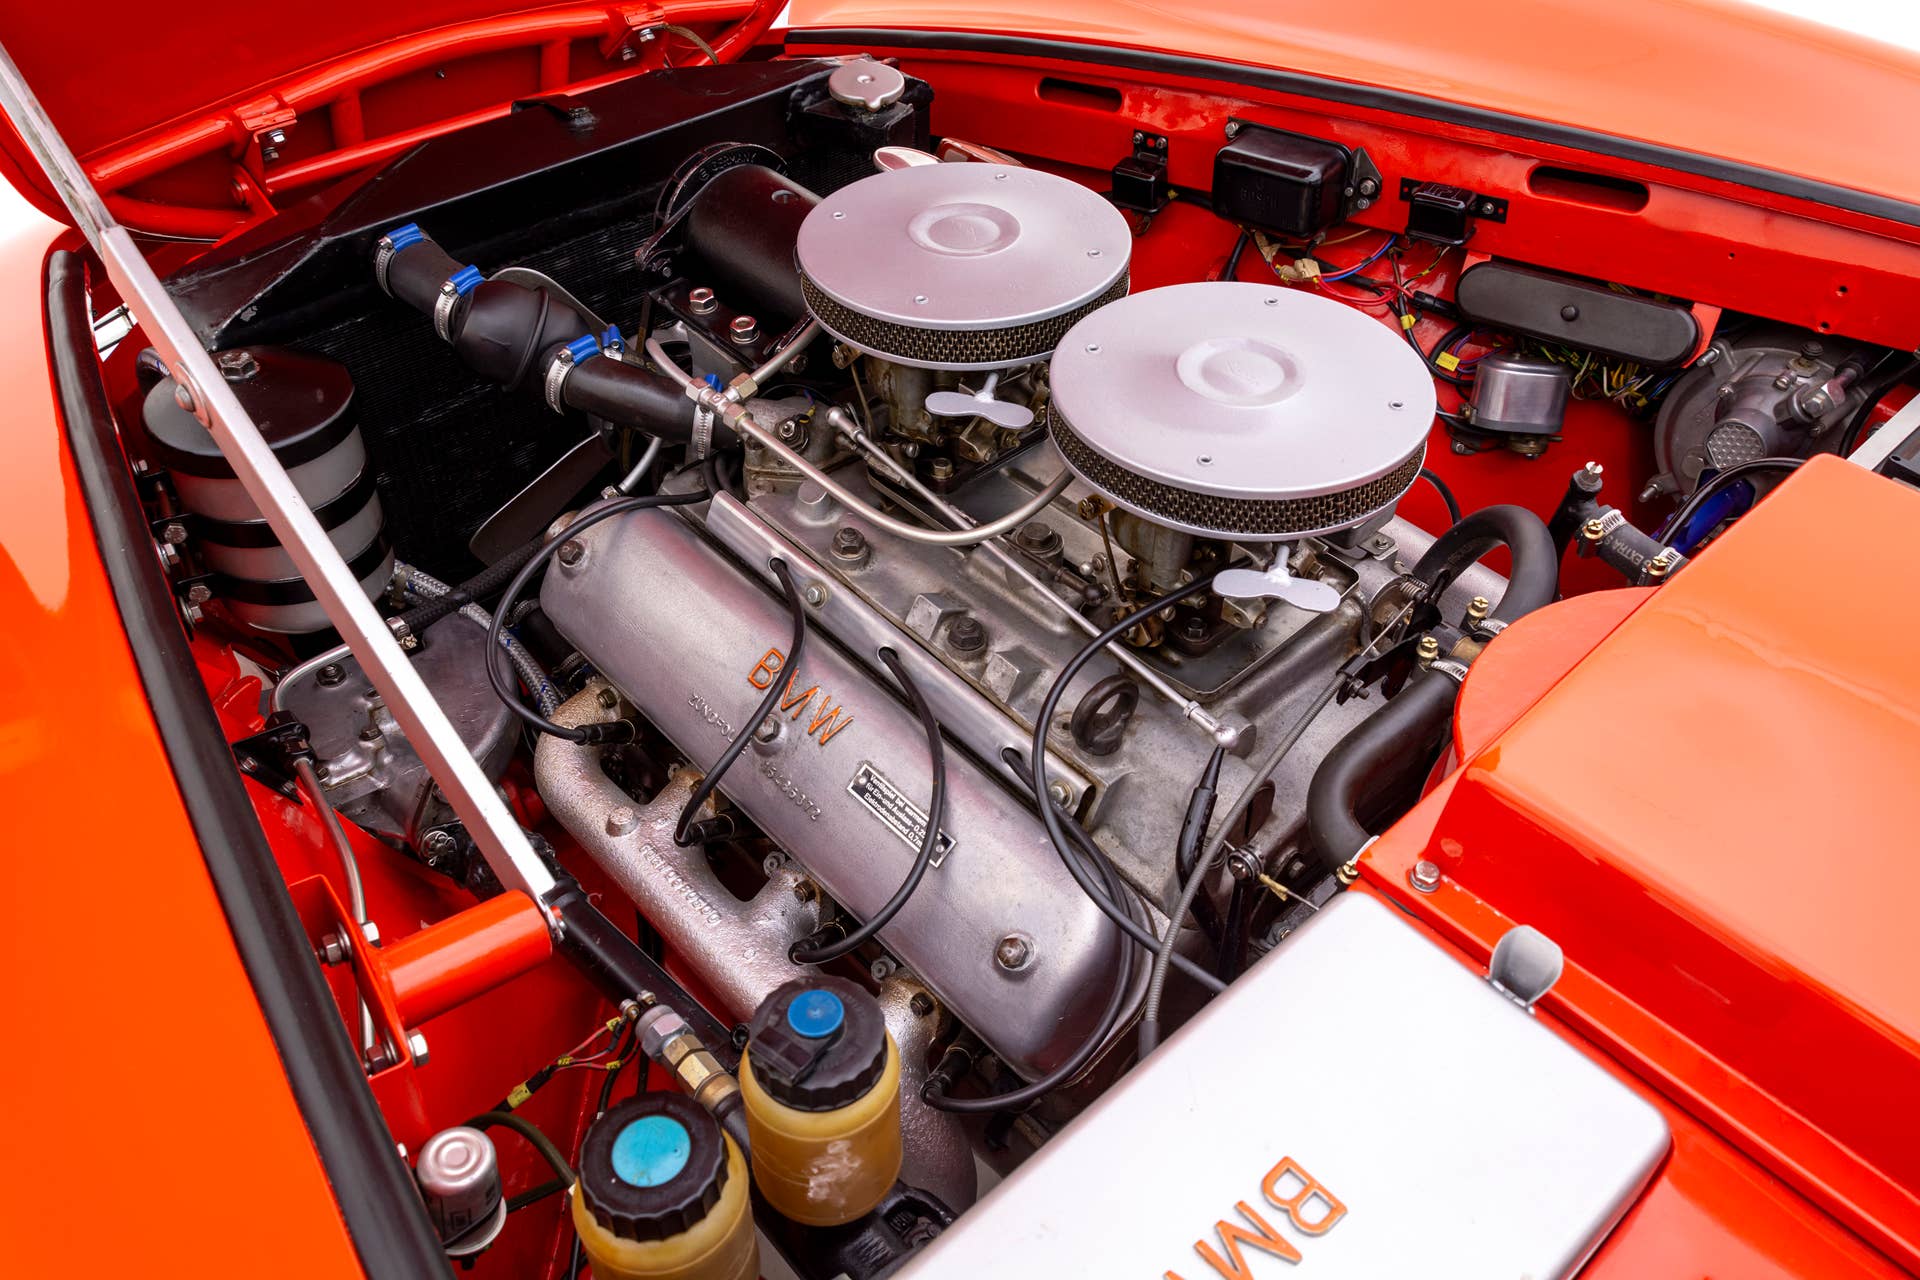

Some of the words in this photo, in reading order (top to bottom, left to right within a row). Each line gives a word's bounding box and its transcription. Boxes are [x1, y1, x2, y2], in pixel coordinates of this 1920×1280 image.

[1611, 538, 1644, 566] EXTRA
[748, 648, 854, 746] BMW
[865, 782, 875, 792] für
[1163, 1156, 1348, 1280] BM
